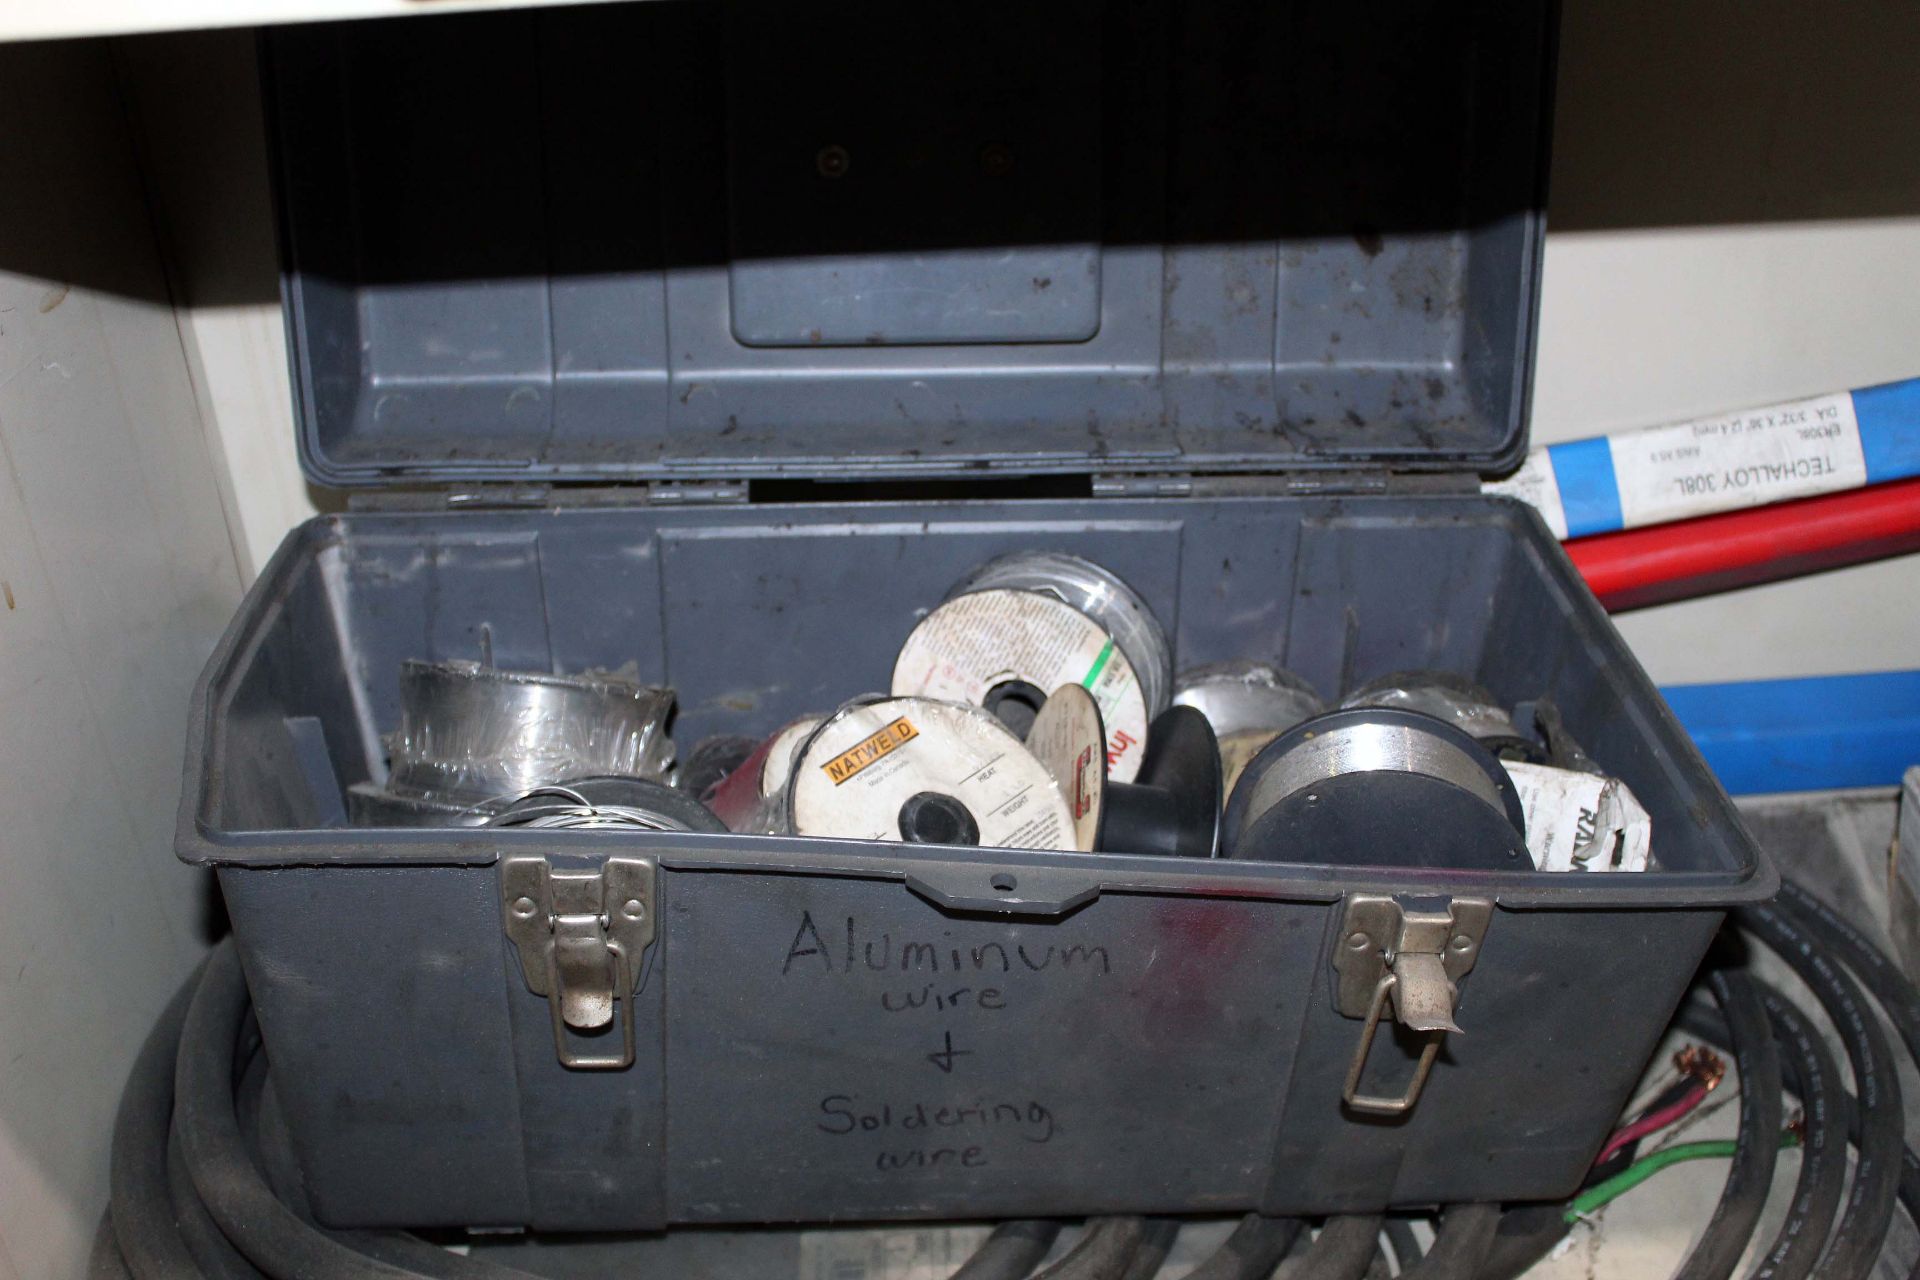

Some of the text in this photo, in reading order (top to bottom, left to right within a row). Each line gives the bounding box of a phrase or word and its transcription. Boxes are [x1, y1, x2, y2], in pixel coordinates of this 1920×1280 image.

[1674, 457, 1836, 496] TECHALLOY 308L
[829, 722, 911, 780] NATWELD
[978, 767, 996, 783] HEAT
[1002, 795, 1029, 817] WEIGHT
[782, 910, 1111, 976] Aluminum
[881, 983, 1007, 1012] wire
[818, 1094, 1055, 1143] Soldering
[876, 1146, 988, 1171] wire
